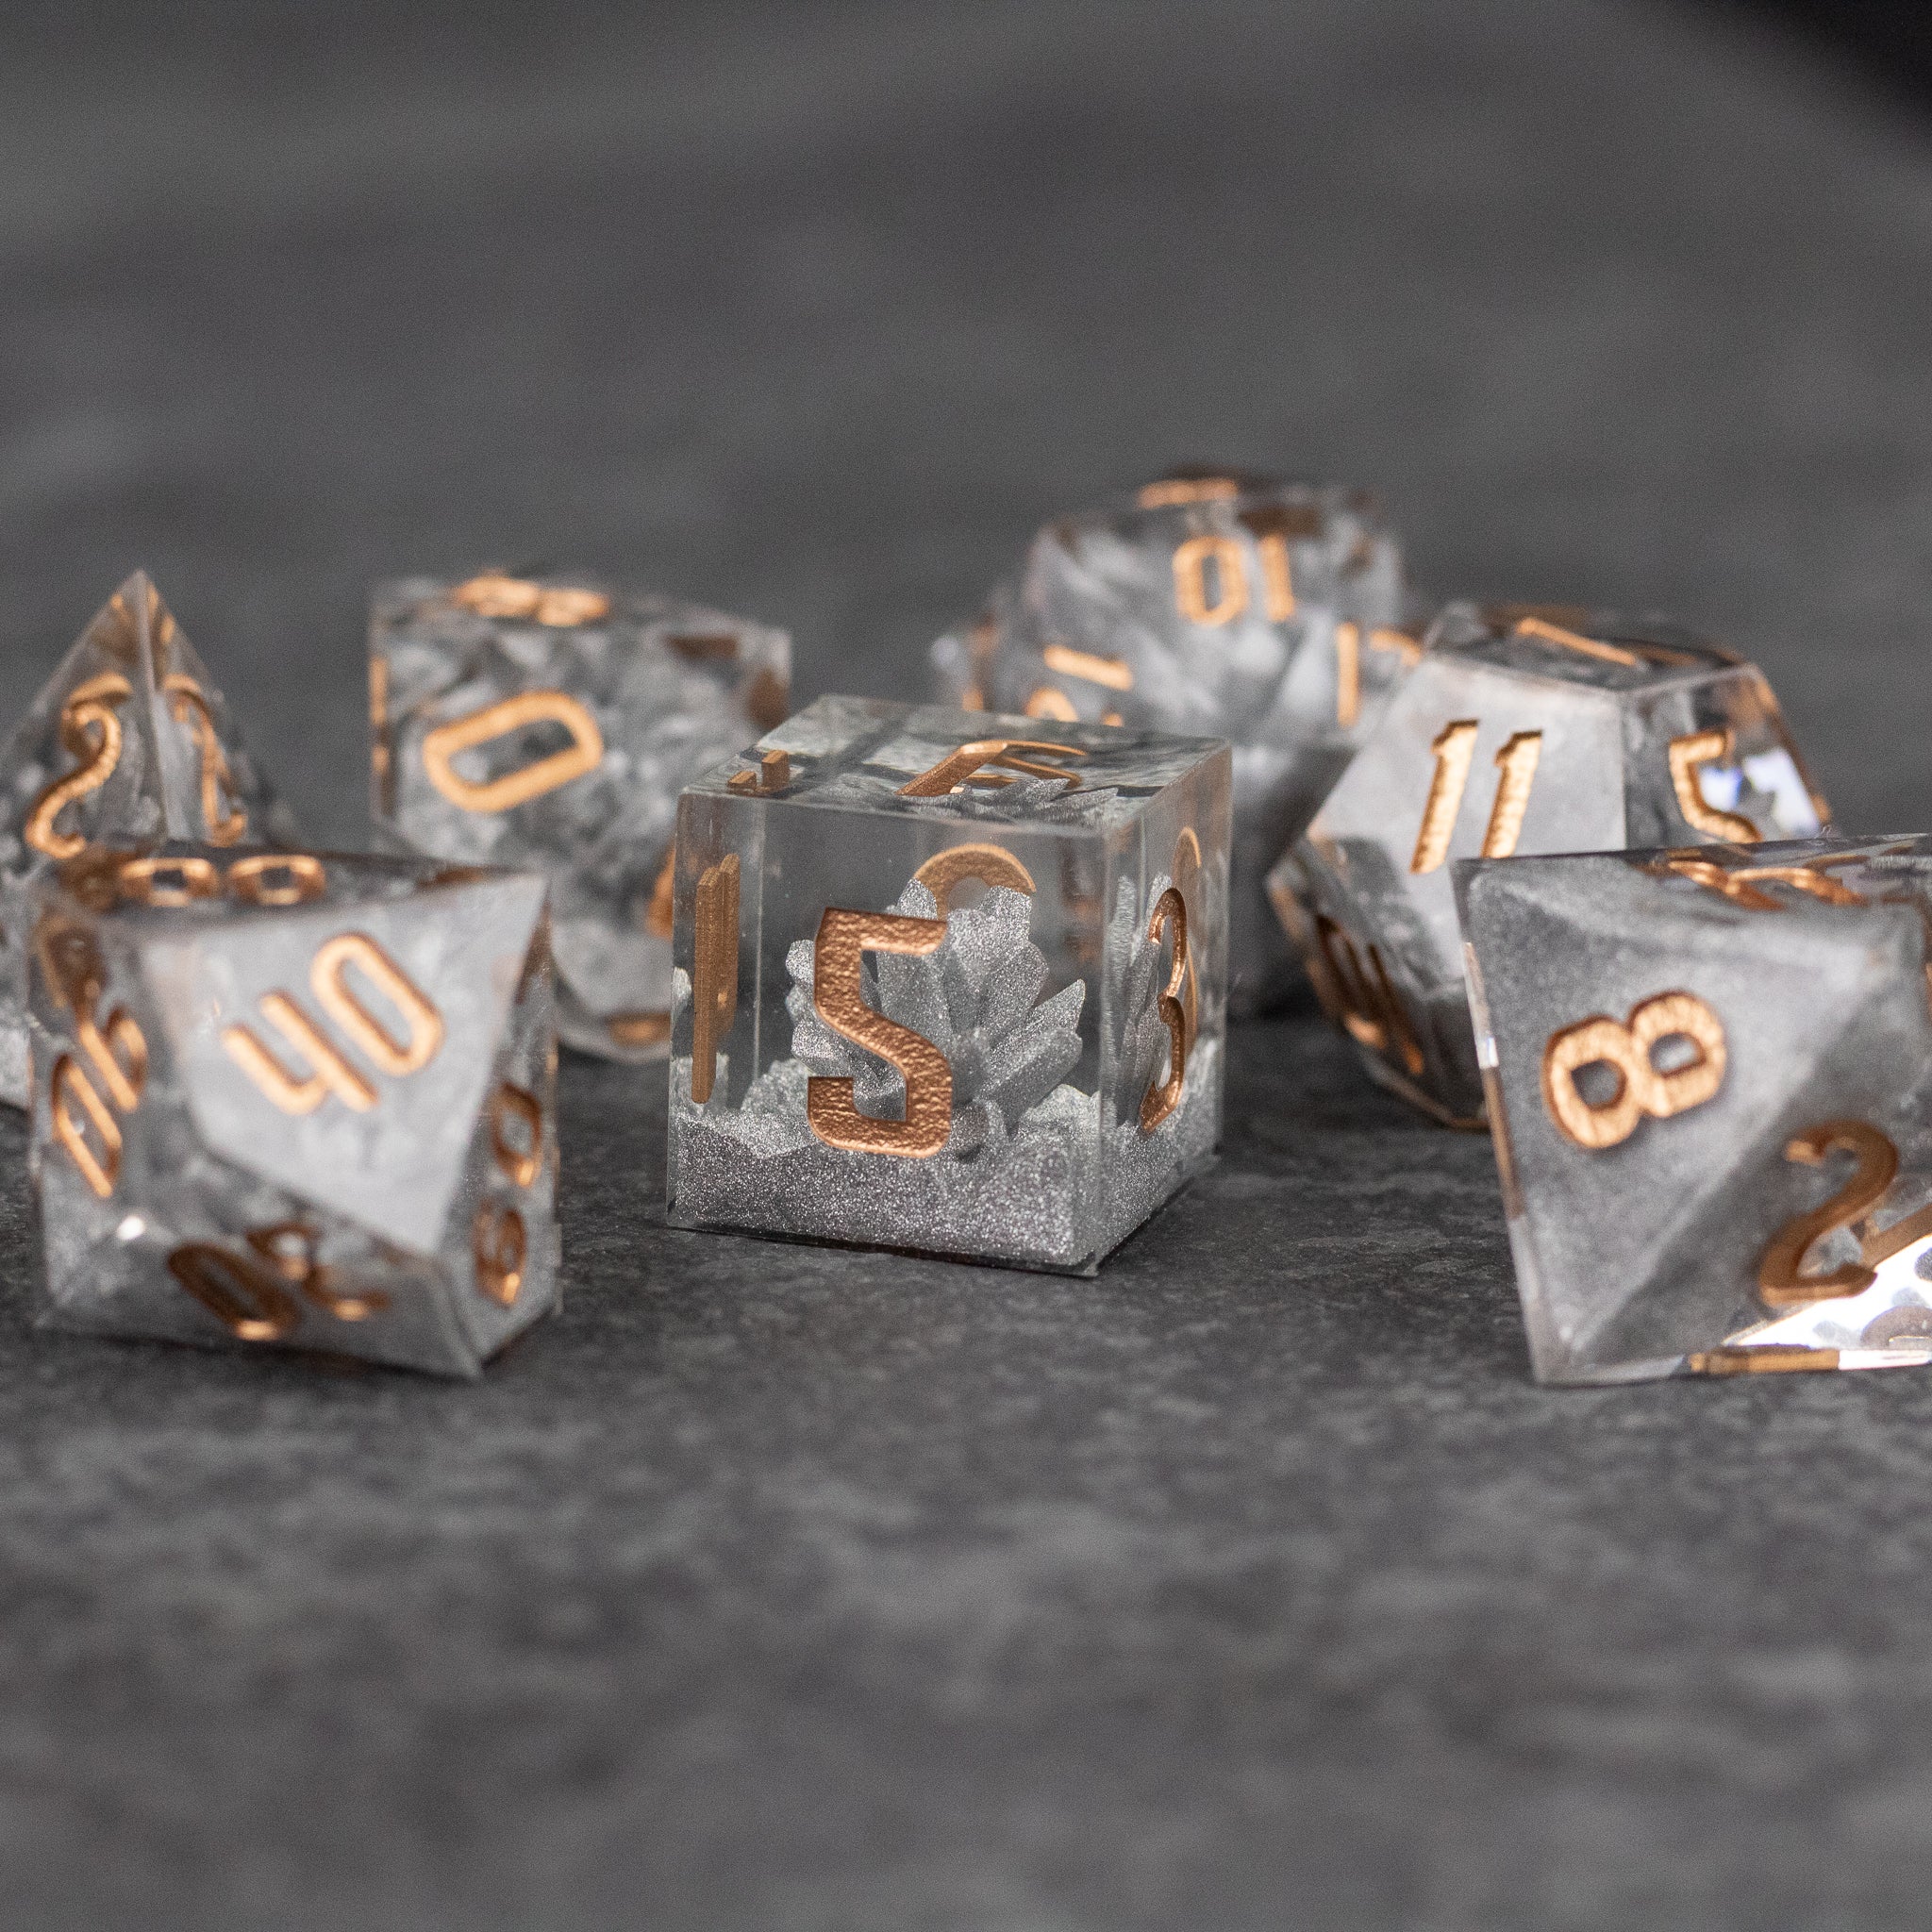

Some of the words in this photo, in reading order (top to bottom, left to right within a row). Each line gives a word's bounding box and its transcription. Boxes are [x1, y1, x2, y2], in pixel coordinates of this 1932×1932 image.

[1409, 719, 1543, 875] 11
[220, 929, 443, 1116] 40
[807, 907, 953, 1159] 5
[1140, 886, 1187, 1134] 3
[1541, 989, 1726, 1150] 8
[1757, 1119, 1898, 1307] 2
